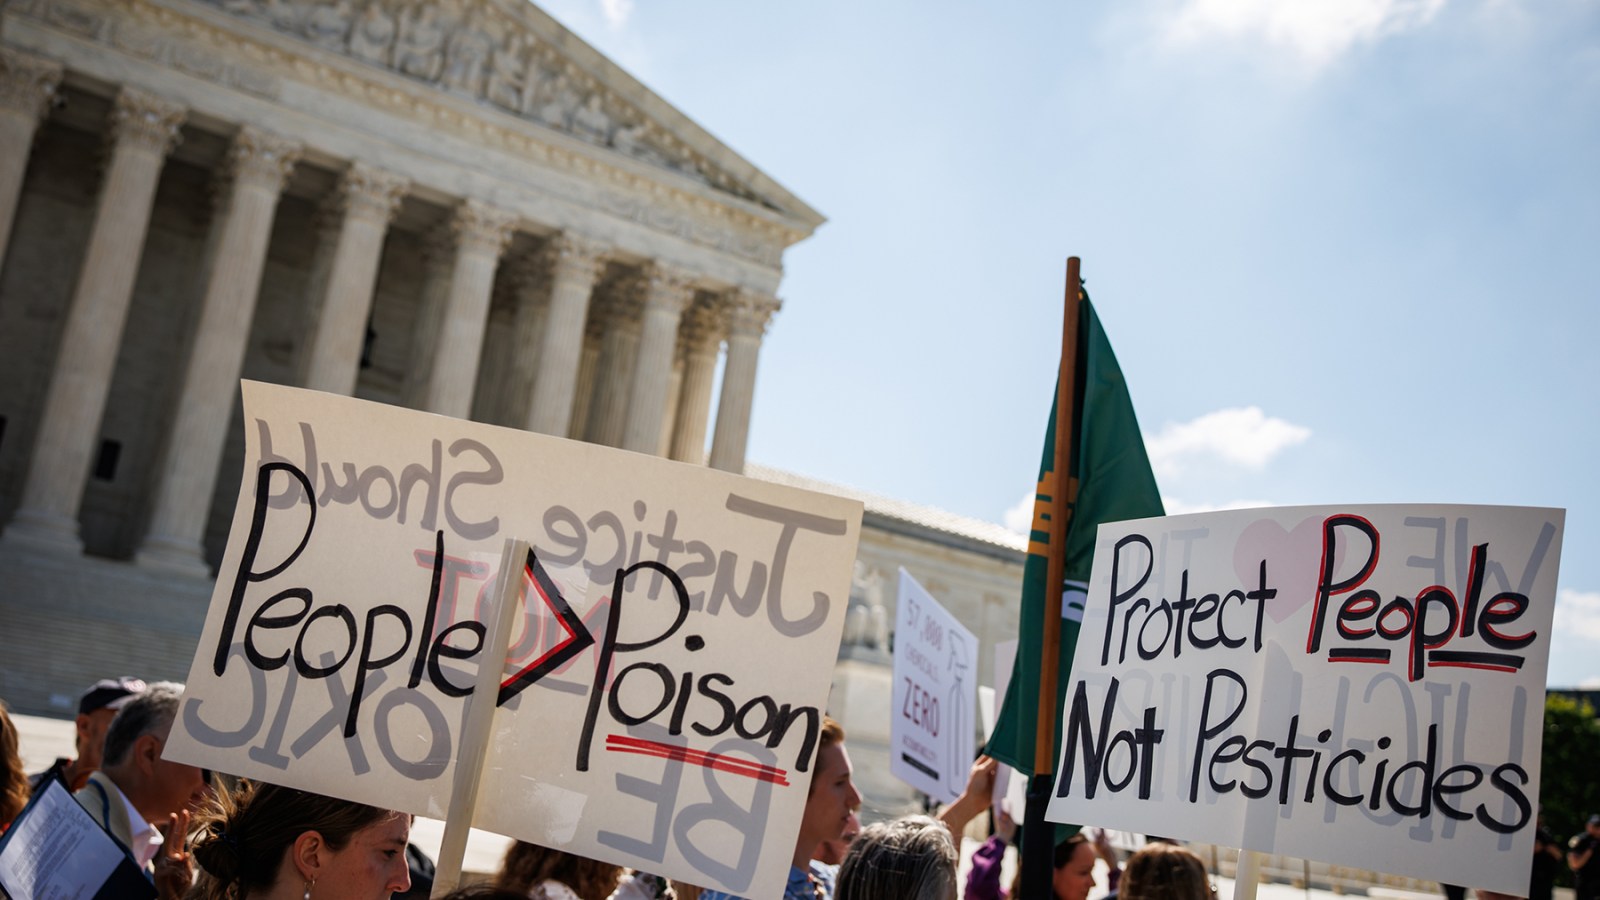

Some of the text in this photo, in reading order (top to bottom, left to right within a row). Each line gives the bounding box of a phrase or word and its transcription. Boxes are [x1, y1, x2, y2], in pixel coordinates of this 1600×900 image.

[213, 462, 486, 738] People
[576, 561, 820, 772] Poison
[1101, 513, 1537, 682] Protect People
[903, 676, 941, 738] ZERO
[1056, 669, 1532, 834] Not Pesticides
